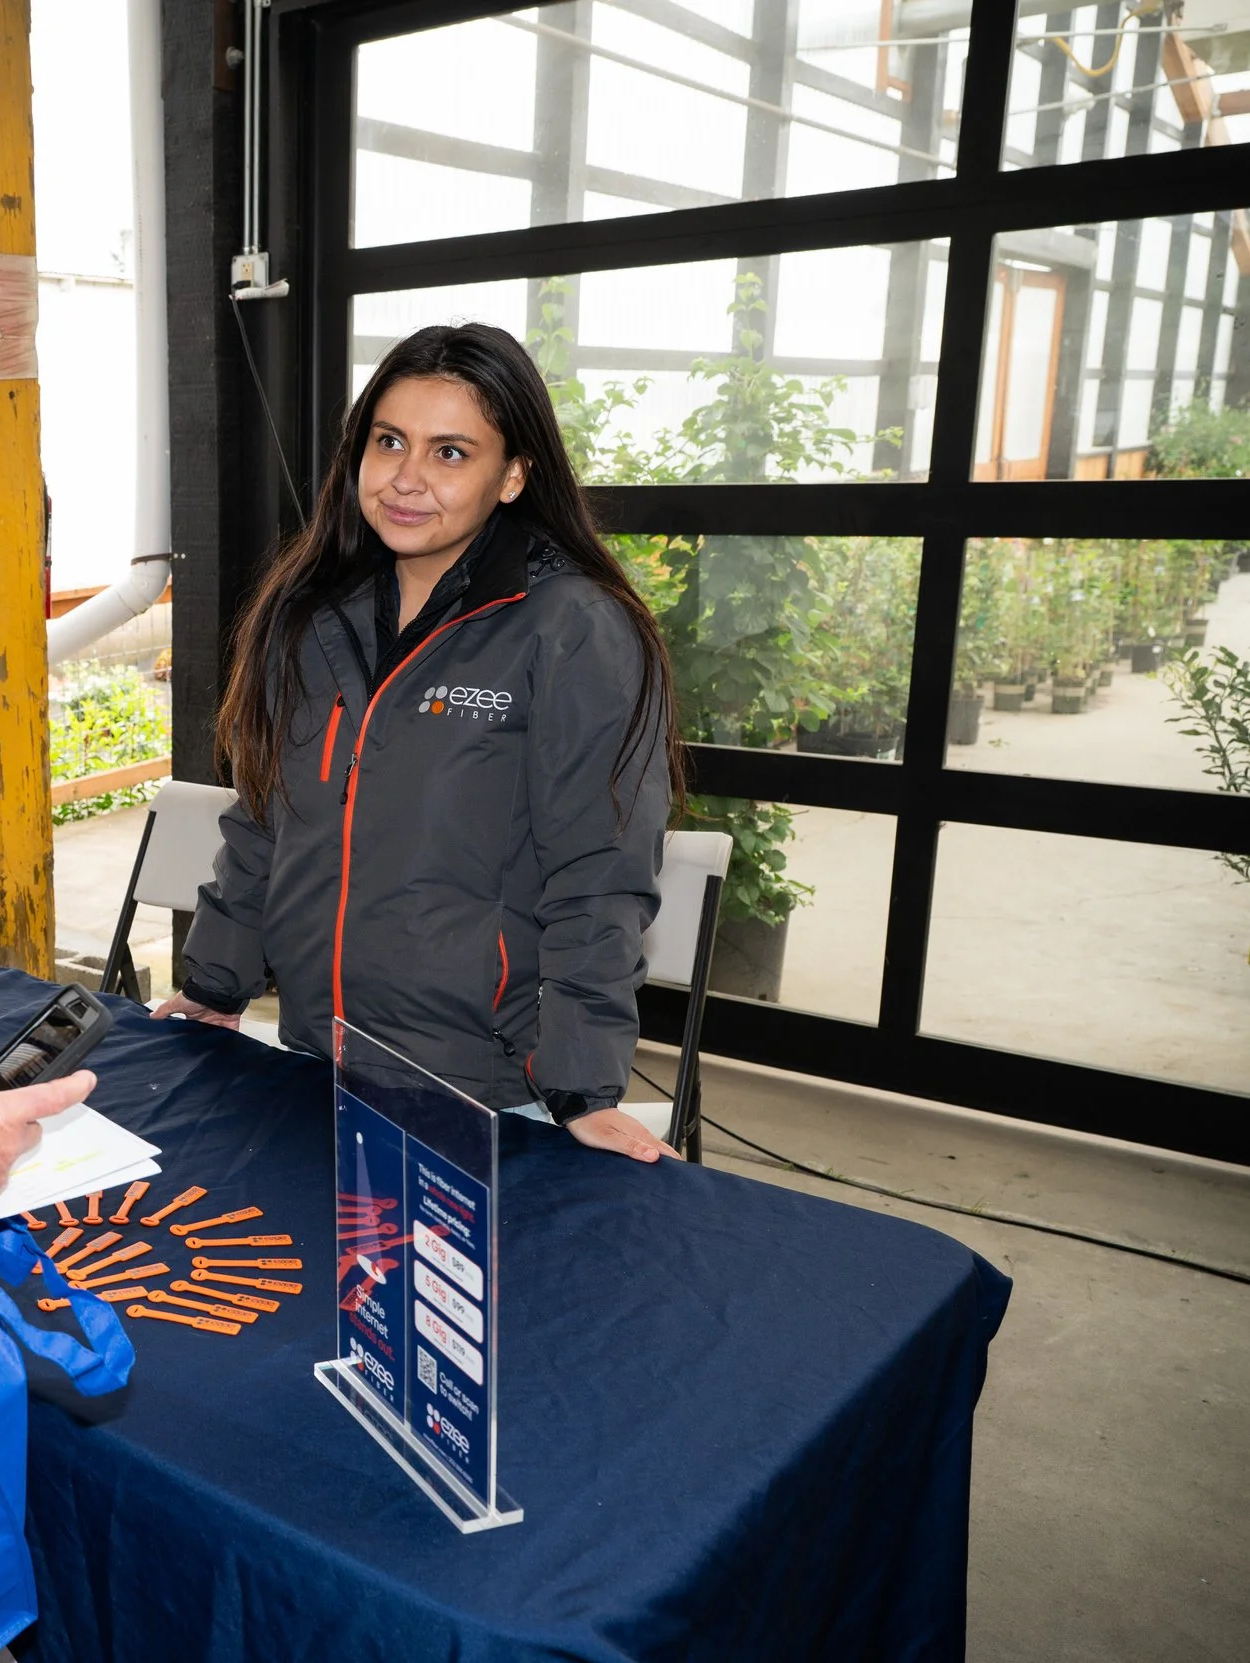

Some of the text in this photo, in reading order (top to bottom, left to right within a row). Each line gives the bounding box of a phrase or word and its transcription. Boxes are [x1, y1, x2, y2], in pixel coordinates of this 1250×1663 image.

[450, 686, 512, 710] ezee
[447, 708, 507, 722] FIBER
[425, 1234, 430, 1247] 2
[431, 1239, 446, 1262] Gig
[356, 1284, 385, 1319] Simple
[425, 1275, 430, 1287] 5
[432, 1280, 446, 1303] Gig
[355, 1298, 388, 1339] internet
[432, 1320, 446, 1343] Gig
[364, 1352, 394, 1391] ezee
[440, 1416, 470, 1454] ezee
